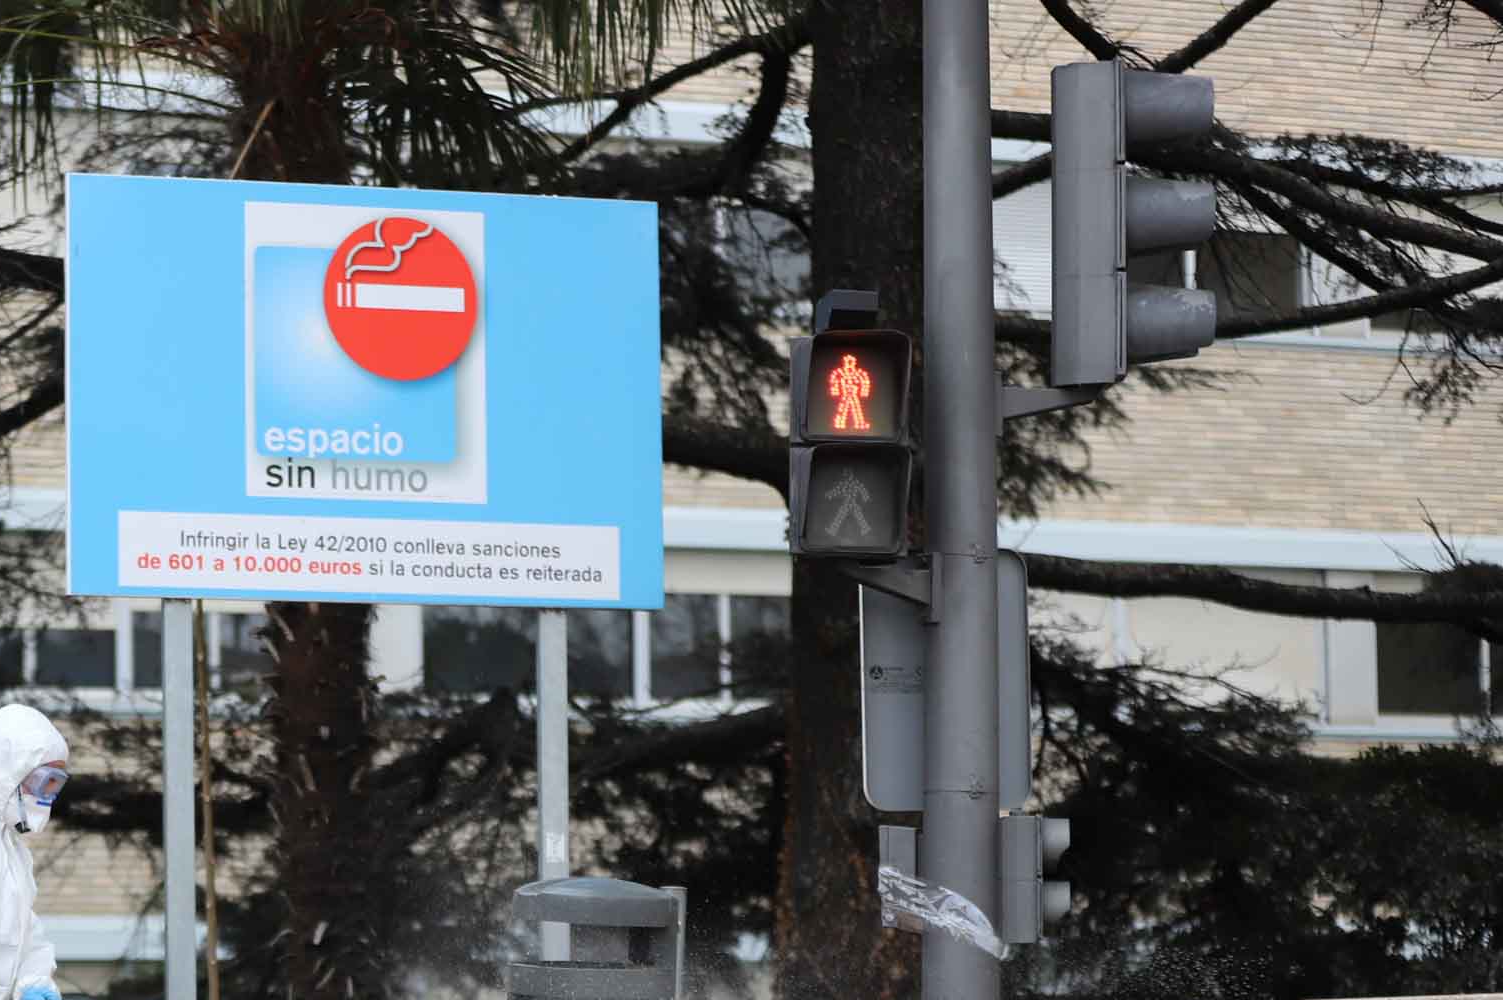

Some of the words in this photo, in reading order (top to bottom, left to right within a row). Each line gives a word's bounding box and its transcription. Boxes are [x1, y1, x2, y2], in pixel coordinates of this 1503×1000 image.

[264, 423, 405, 458] espacio
[265, 457, 316, 488] sin
[331, 459, 428, 493] humo
[180, 530, 249, 551] Infringir
[256, 532, 271, 550] la
[278, 533, 308, 552] Ley
[314, 535, 387, 554] 42/2010
[393, 537, 466, 556] conlleva
[472, 541, 562, 559] sanciones
[137, 553, 161, 570] de
[168, 554, 204, 571] 601
[213, 558, 225, 571] a
[233, 556, 302, 574] 10.000
[308, 559, 362, 576] euros
[369, 560, 383, 576] si
[390, 560, 405, 577] la
[411, 562, 493, 580] conducta
[499, 566, 520, 580] es
[526, 565, 603, 583] reiterada
